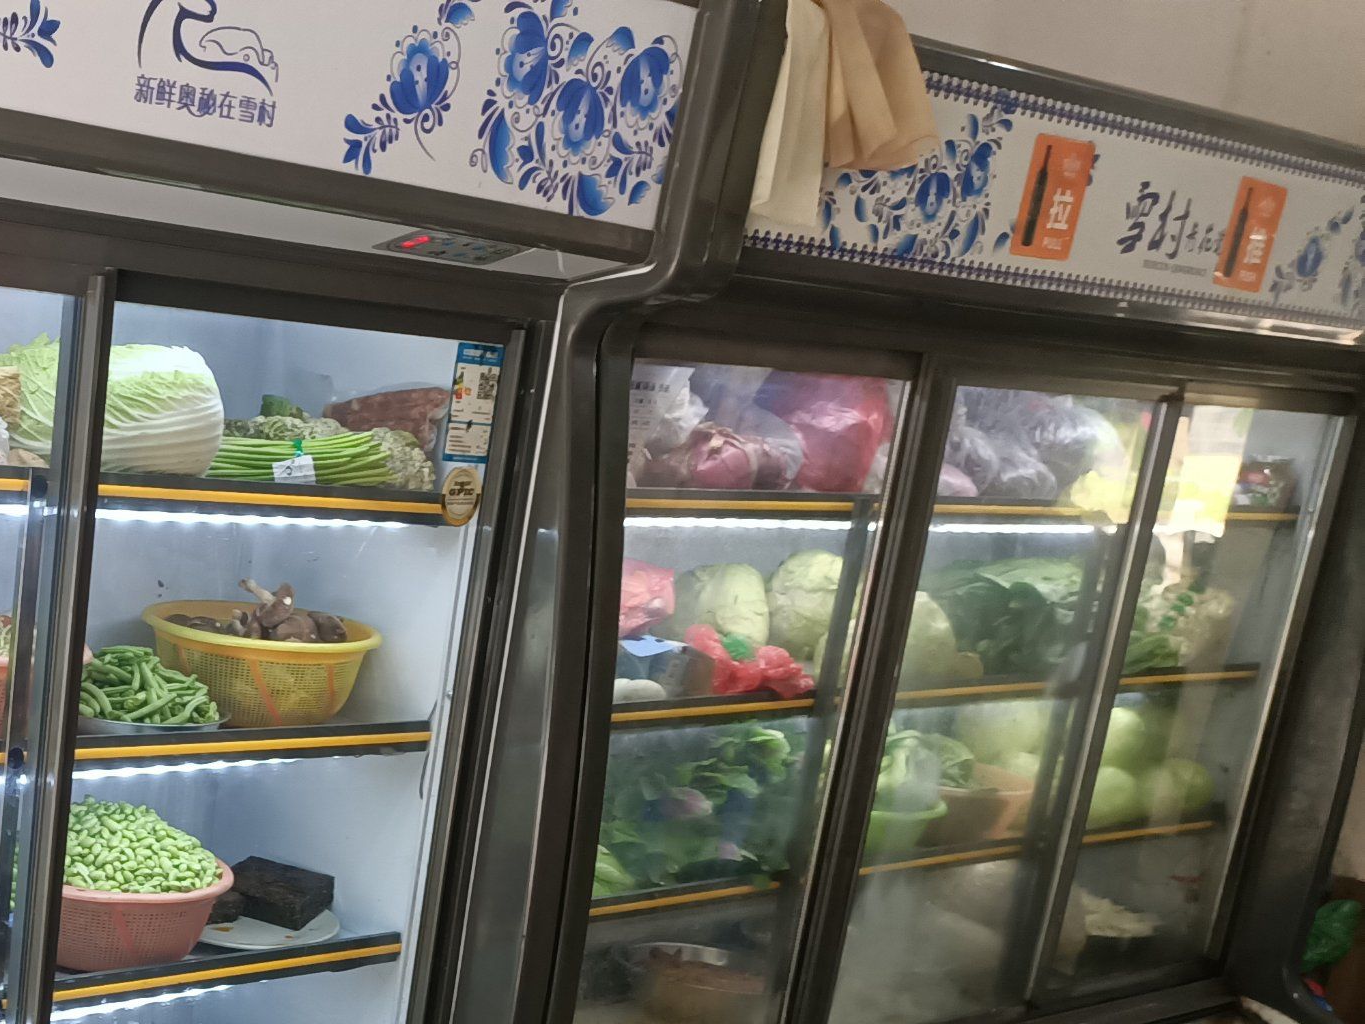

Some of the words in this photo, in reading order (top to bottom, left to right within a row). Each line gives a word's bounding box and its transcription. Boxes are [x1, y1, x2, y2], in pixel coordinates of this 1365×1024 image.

[134, 74, 277, 128] 新鲜奥秘在雪村
[1046, 188, 1074, 230] 拉
